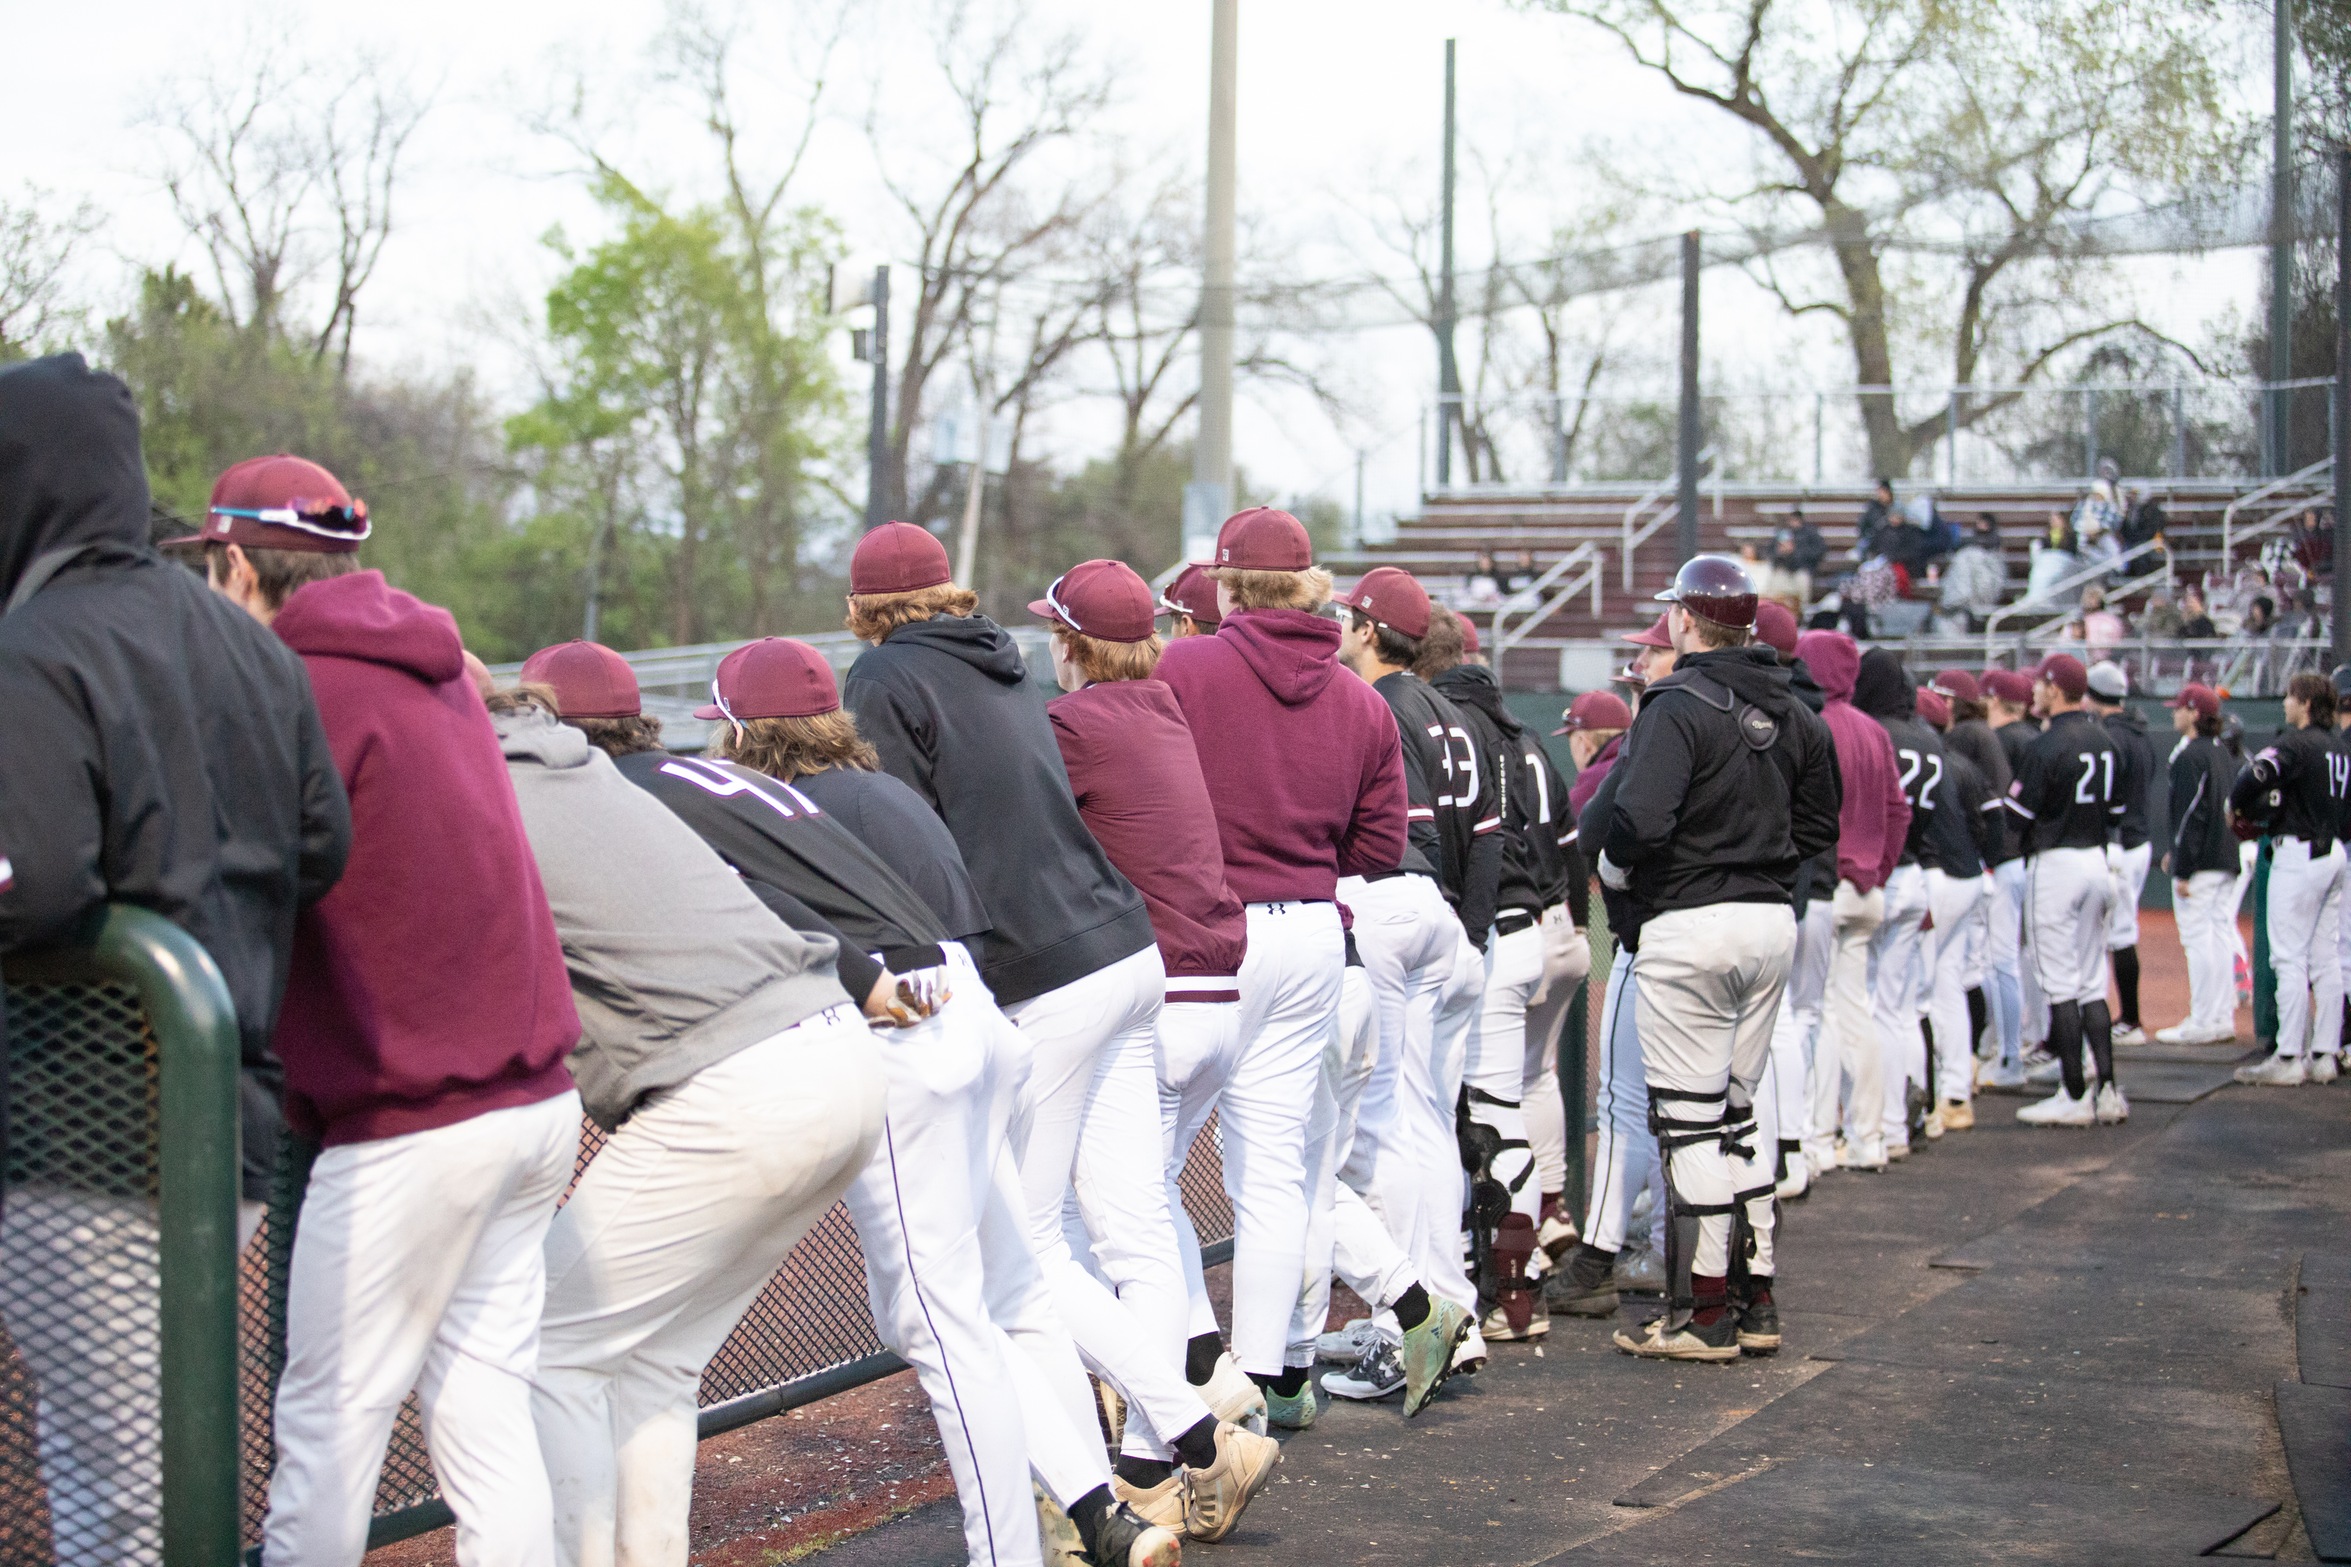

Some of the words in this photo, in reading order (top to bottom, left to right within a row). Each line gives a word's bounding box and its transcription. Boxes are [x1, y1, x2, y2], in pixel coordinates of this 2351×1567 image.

[1898, 748, 1943, 810] 22
[2075, 750, 2113, 804] 21
[2325, 751, 2350, 800] 14
